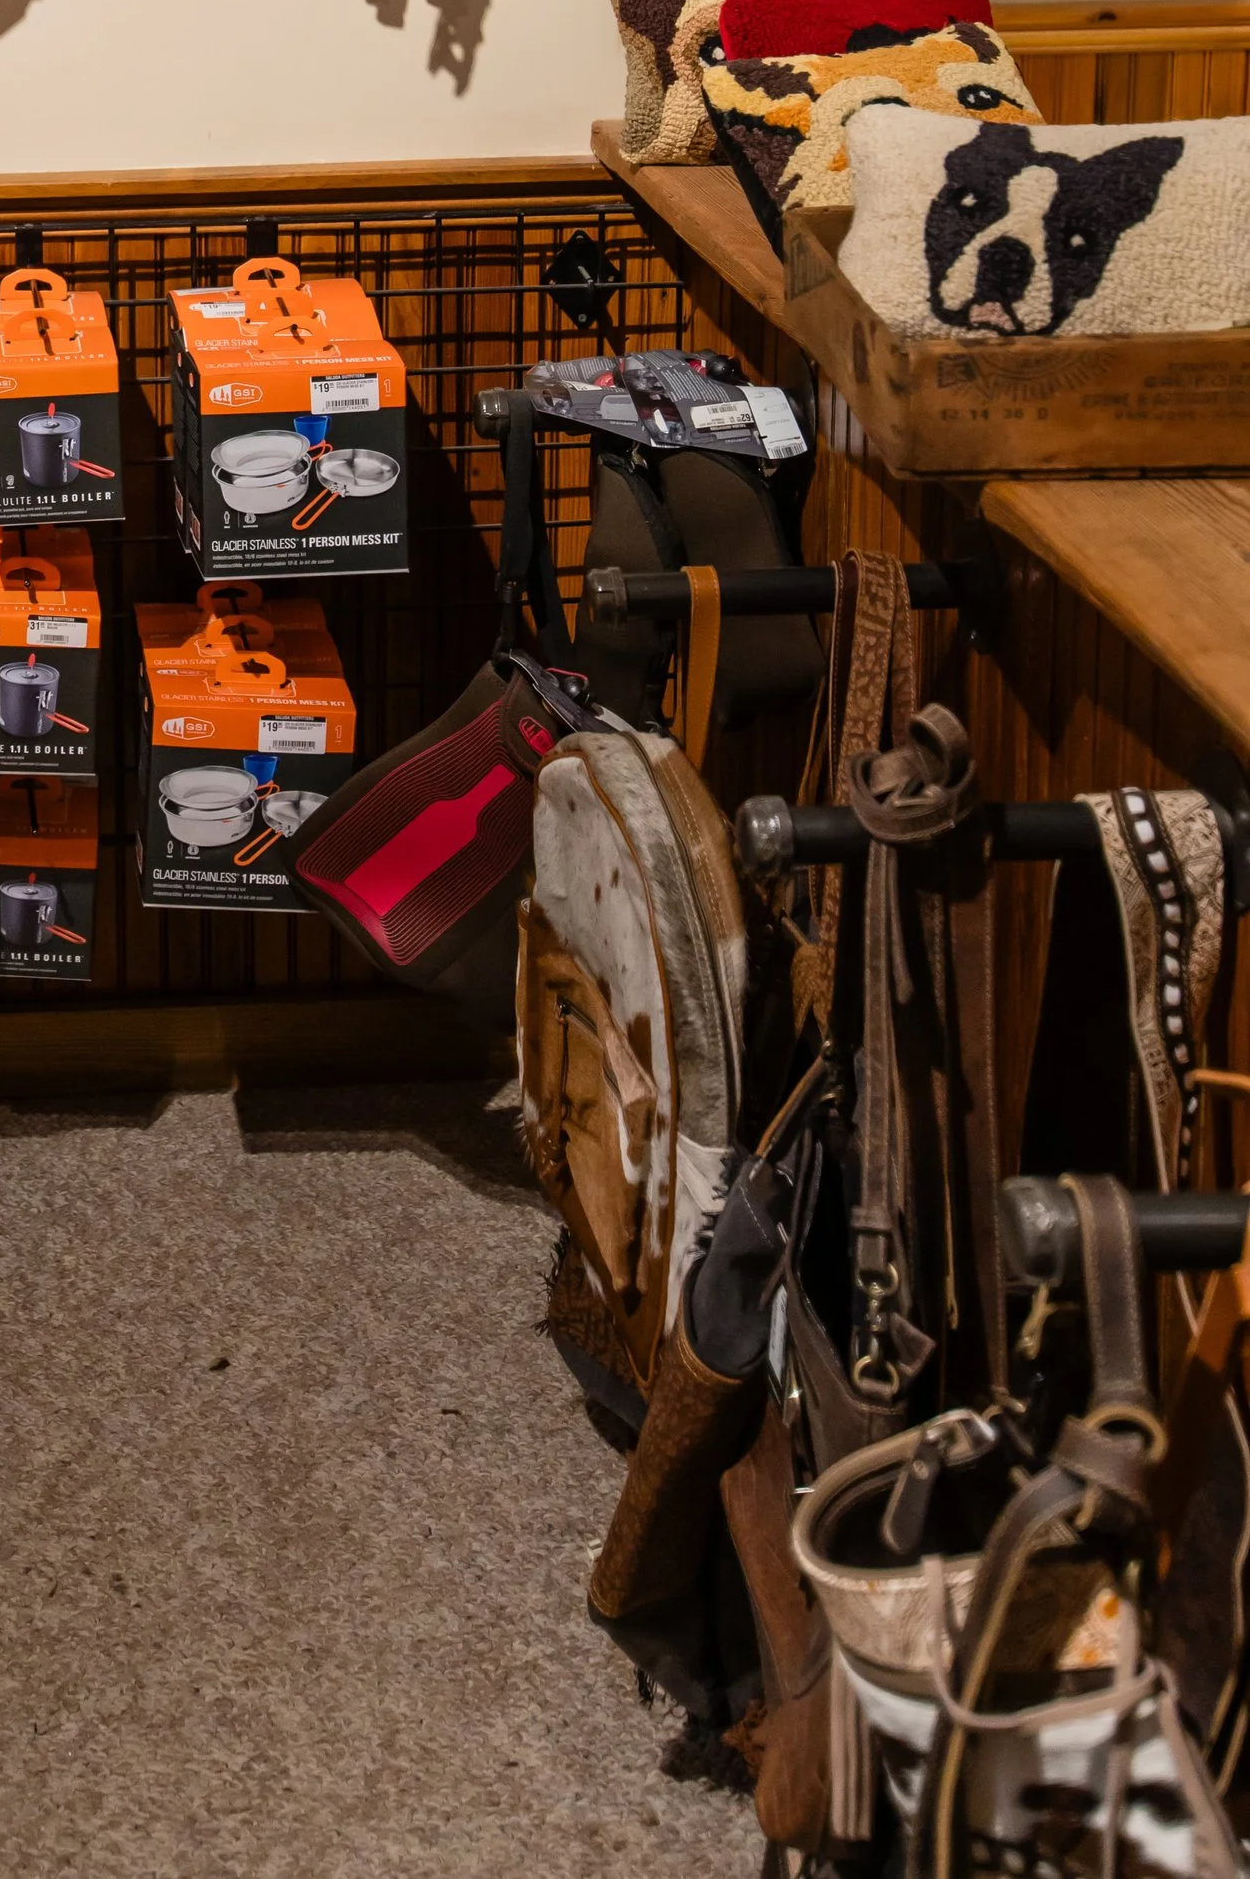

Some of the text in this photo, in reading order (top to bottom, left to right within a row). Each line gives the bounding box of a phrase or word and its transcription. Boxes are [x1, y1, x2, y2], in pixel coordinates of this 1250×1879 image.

[195, 339, 230, 347] GLACIER
[54, 353, 105, 361] BOILER
[375, 355, 393, 363] KIT
[233, 388, 256, 398] GSI
[61, 491, 112, 503] BOILER
[211, 532, 400, 552] GLACIER STAINLESS 1 PERSON MESS KIT
[161, 693, 198, 701] GLACIER
[256, 698, 299, 706] PERSON
[300, 699, 329, 707] MESS
[186, 724, 207, 732] GSI
[34, 745, 84, 755] BOILER
[153, 868, 290, 886] GLACIER STAINLESS 1 PERSON
[33, 953, 82, 963] BOILER
